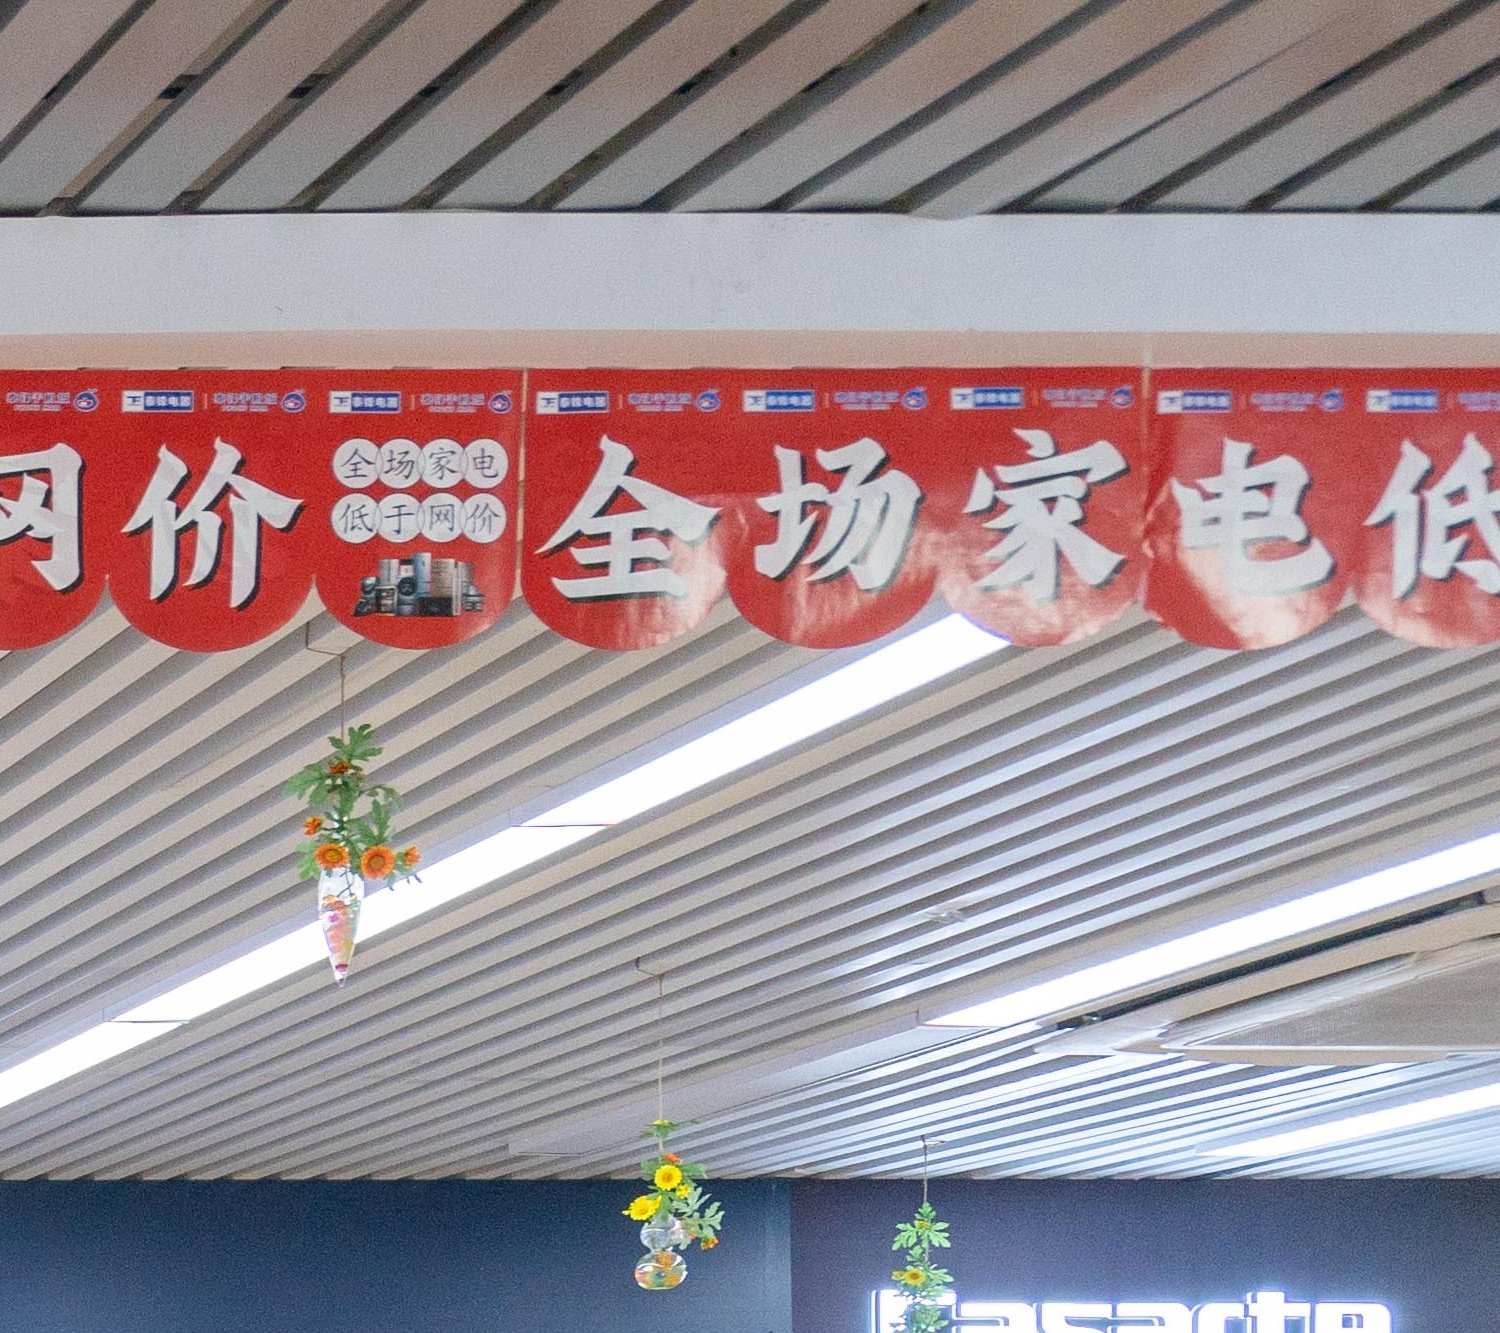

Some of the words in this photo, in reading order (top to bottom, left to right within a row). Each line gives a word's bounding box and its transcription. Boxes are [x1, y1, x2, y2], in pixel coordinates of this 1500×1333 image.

[340, 446, 500, 480] 全场家电
[340, 501, 500, 535] 低于网价
